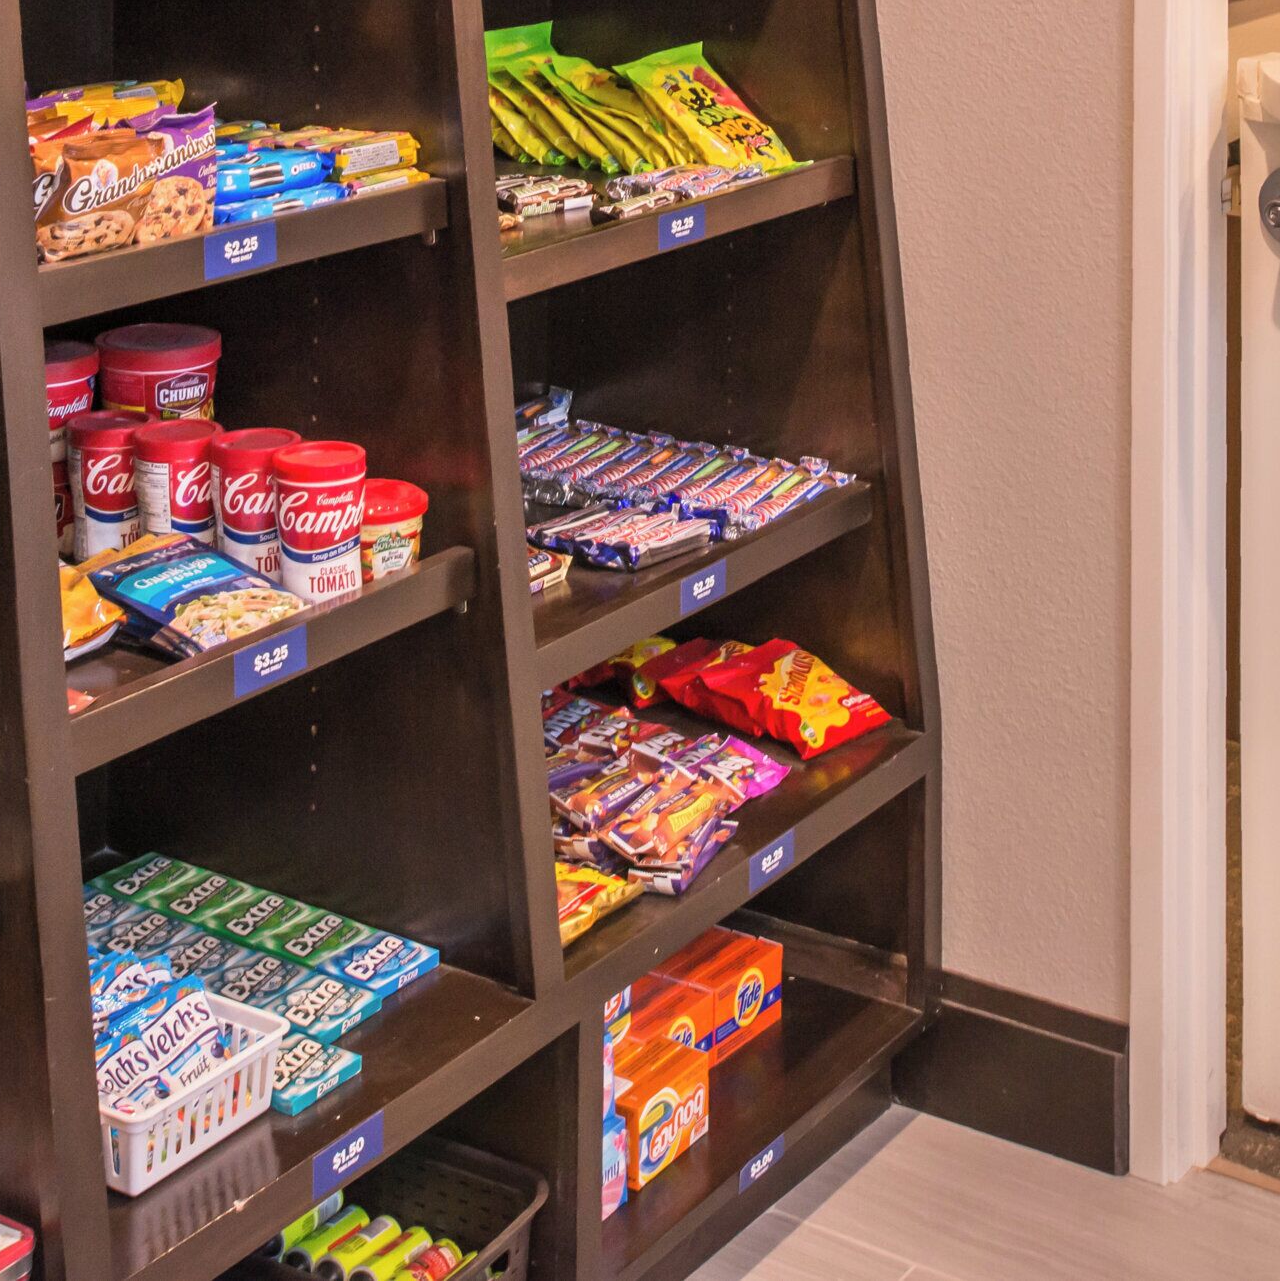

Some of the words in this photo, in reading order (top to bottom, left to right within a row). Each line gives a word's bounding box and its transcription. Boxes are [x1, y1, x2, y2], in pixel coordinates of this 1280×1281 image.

[290, 159, 317, 175] OREO
[671, 216, 694, 235] $2.25
[224, 236, 258, 260] $2.25
[159, 383, 207, 404] CHUNKY
[317, 491, 353, 506] Campbell's
[312, 552, 327, 562] Soup
[327, 550, 336, 558] on
[337, 545, 347, 554] the
[320, 564, 347, 574] CLASSIC
[309, 570, 356, 593] TOMATO
[693, 575, 715, 596] $2.25
[254, 644, 289, 673] $3.25
[113, 856, 171, 895] Extra
[170, 876, 228, 915] Extra
[225, 895, 285, 936] Extra
[107, 913, 168, 953] Extra
[285, 916, 343, 957] Extra
[345, 935, 404, 981] Extra
[221, 956, 281, 1002] Extra
[285, 979, 343, 1026] Extra
[738, 983, 761, 1018] Tide
[179, 1055, 210, 1087] Fruit
[332, 1137, 365, 1173] $1.50
